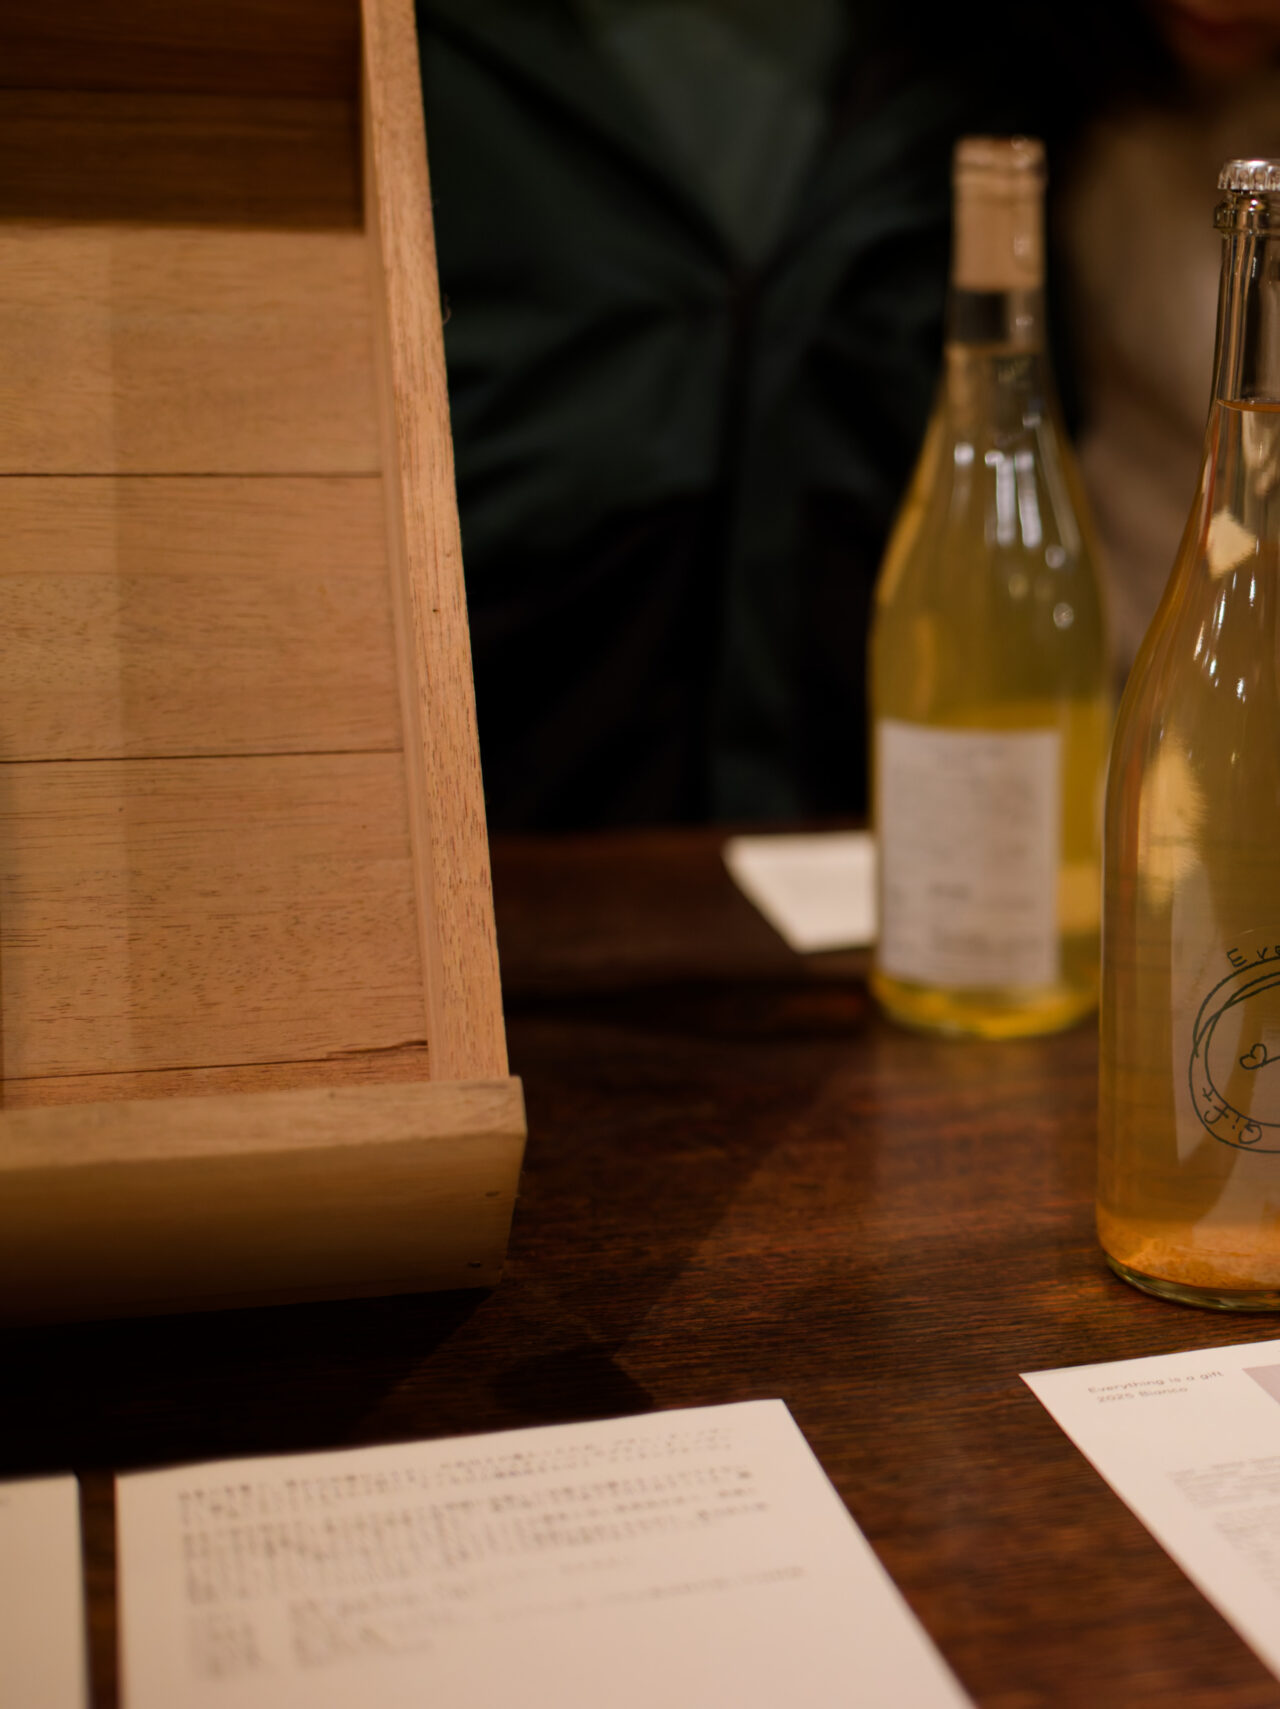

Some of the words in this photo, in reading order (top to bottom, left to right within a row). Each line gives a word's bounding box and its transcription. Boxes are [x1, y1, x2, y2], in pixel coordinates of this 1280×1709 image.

[1087, 1378, 1165, 1394] Everything
[1169, 1376, 1182, 1384] is
[1199, 1370, 1225, 1381] gift
